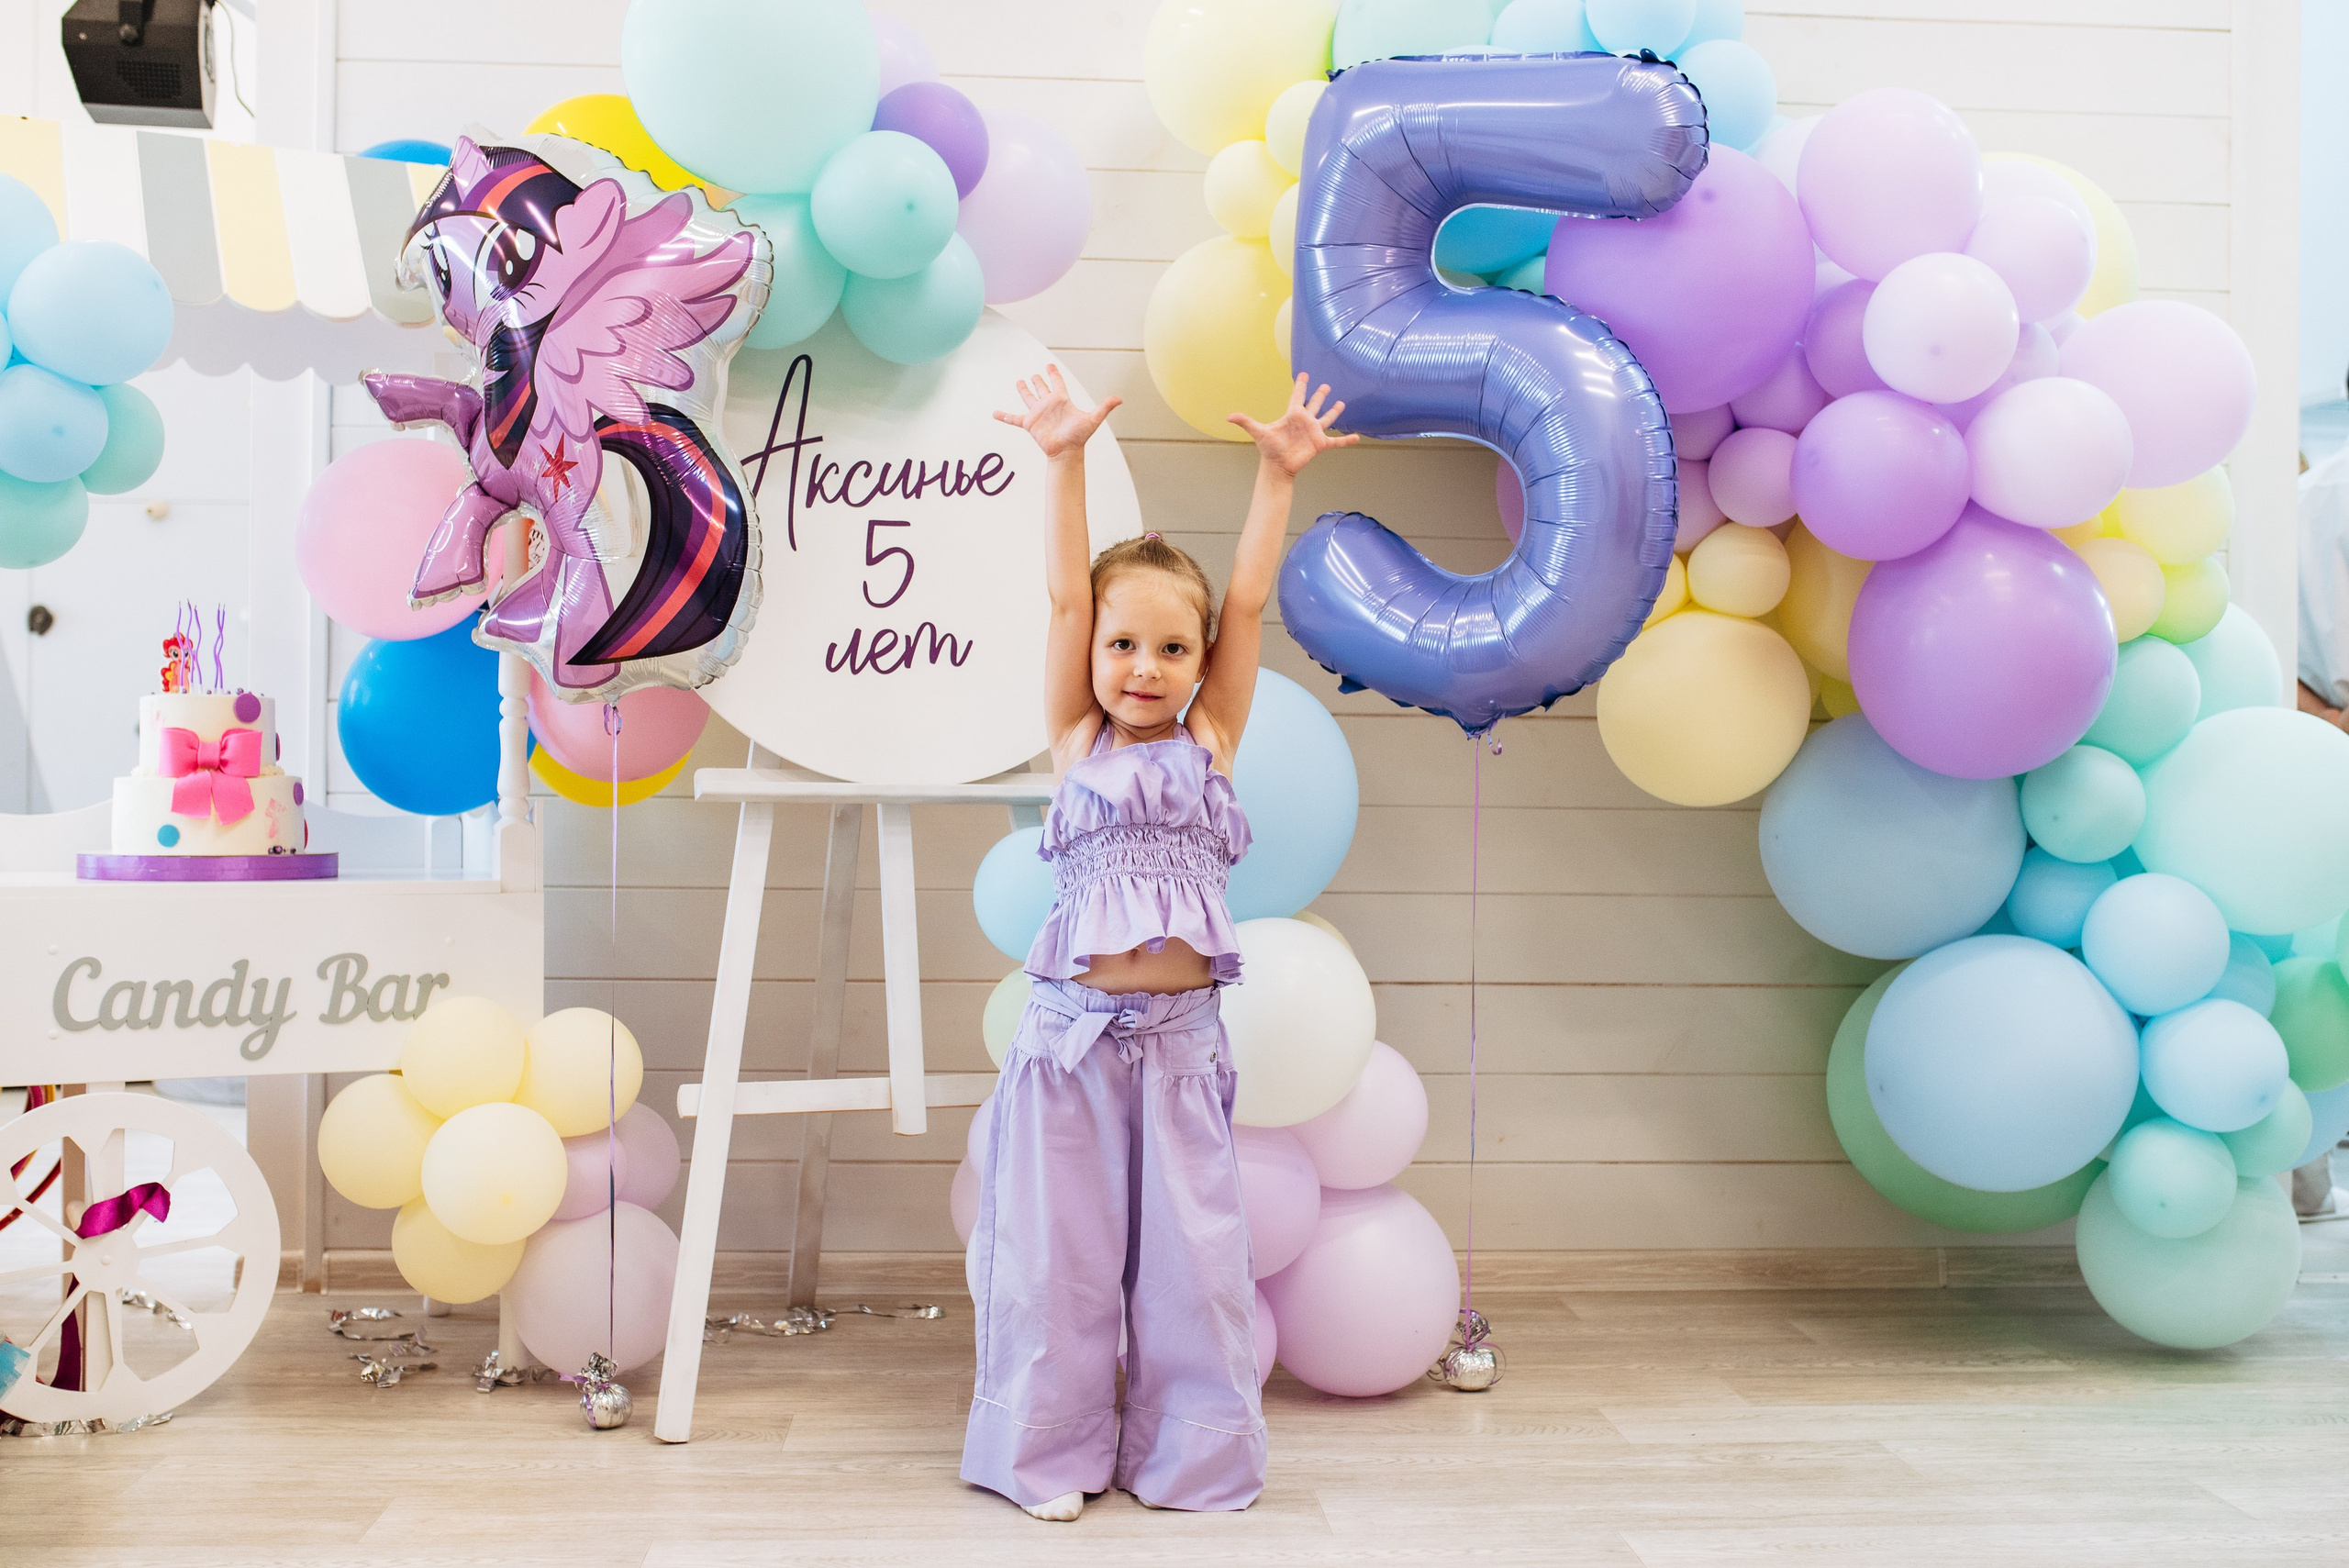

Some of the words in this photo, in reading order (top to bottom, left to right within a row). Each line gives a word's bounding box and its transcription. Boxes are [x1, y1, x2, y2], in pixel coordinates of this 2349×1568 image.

[1279, 49, 1710, 733] 5
[740, 355, 1015, 550] Аксинье
[863, 520, 915, 608] 5
[825, 622, 974, 675] лет
[53, 957, 297, 1061] Candy
[317, 952, 451, 1024] Bar
